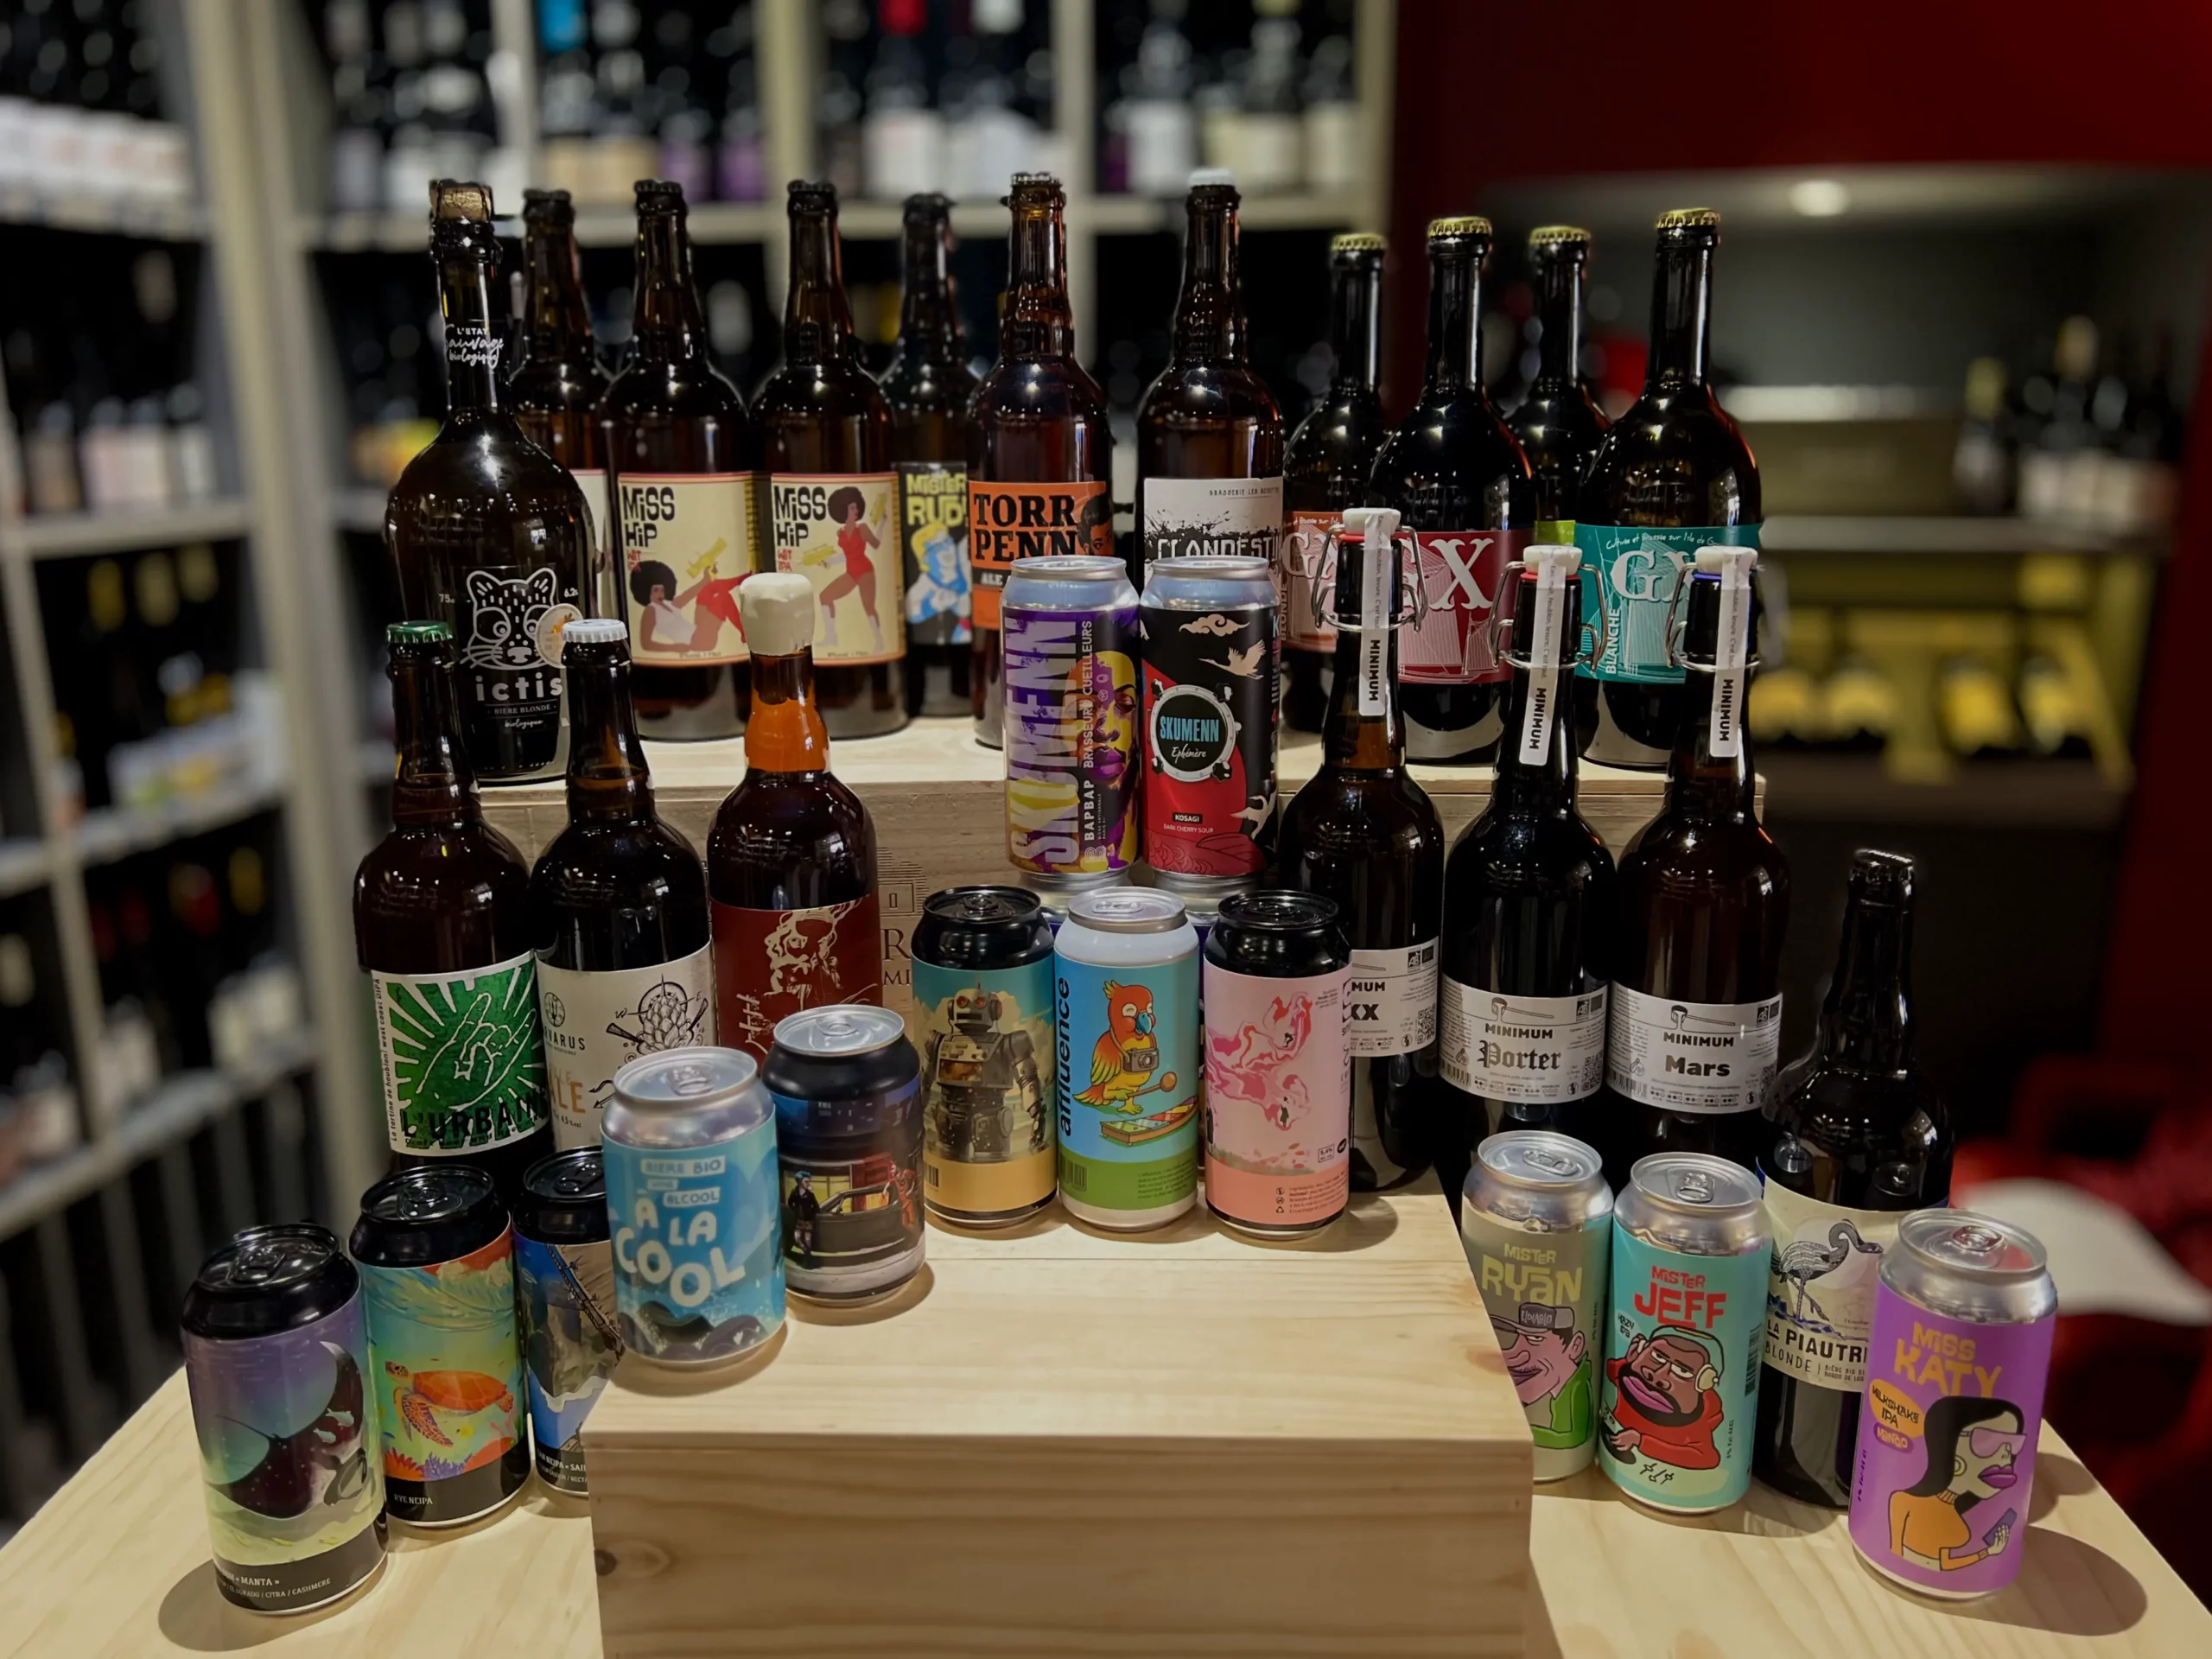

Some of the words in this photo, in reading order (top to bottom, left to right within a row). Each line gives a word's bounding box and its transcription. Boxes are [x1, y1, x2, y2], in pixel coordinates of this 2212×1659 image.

[974, 493, 1078, 527] TORR
[975, 529, 1078, 562] PENN
[981, 572, 1003, 586] ALE
[1605, 607, 1621, 674] BLANCHE
[1082, 620, 1093, 696] CUEILLEURS
[1368, 640, 1381, 702] MINIMUM
[474, 671, 563, 702] ictis
[520, 704, 551, 714] BLONDE
[1529, 688, 1547, 750] MINIMUM
[1719, 678, 1734, 741] MINIMUM
[1005, 617, 1080, 864] SKUMENN
[1160, 716, 1220, 742] SKUMENN
[1084, 779, 1095, 841] BAPBAP
[1174, 814, 1200, 823] KOSAGI
[1484, 1023, 1554, 1039] MINIMUM
[1663, 1032, 1734, 1047] MINIMUM
[1057, 976, 1071, 1137] affluence
[1477, 1039, 1561, 1071] Porter
[1665, 1055, 1731, 1077] Mars
[386, 1089, 393, 1099] de
[386, 1102, 397, 1129] tartine
[693, 1159, 721, 1174] BIO
[666, 1190, 718, 1205] ALCOOL
[668, 1211, 717, 1246] LA
[615, 1227, 747, 1308] COOL
[1634, 1281, 1727, 1329] JEFF
[1767, 1320, 1780, 1334] LA
[1764, 1340, 1812, 1373] BLONDE
[1894, 1338, 2003, 1398] KATY
[1881, 1407, 1899, 1428] IPA
[409, 1497, 434, 1505] NEIPA
[241, 1576, 273, 1586] MANTA
[292, 1578, 332, 1595] CASHMERE
